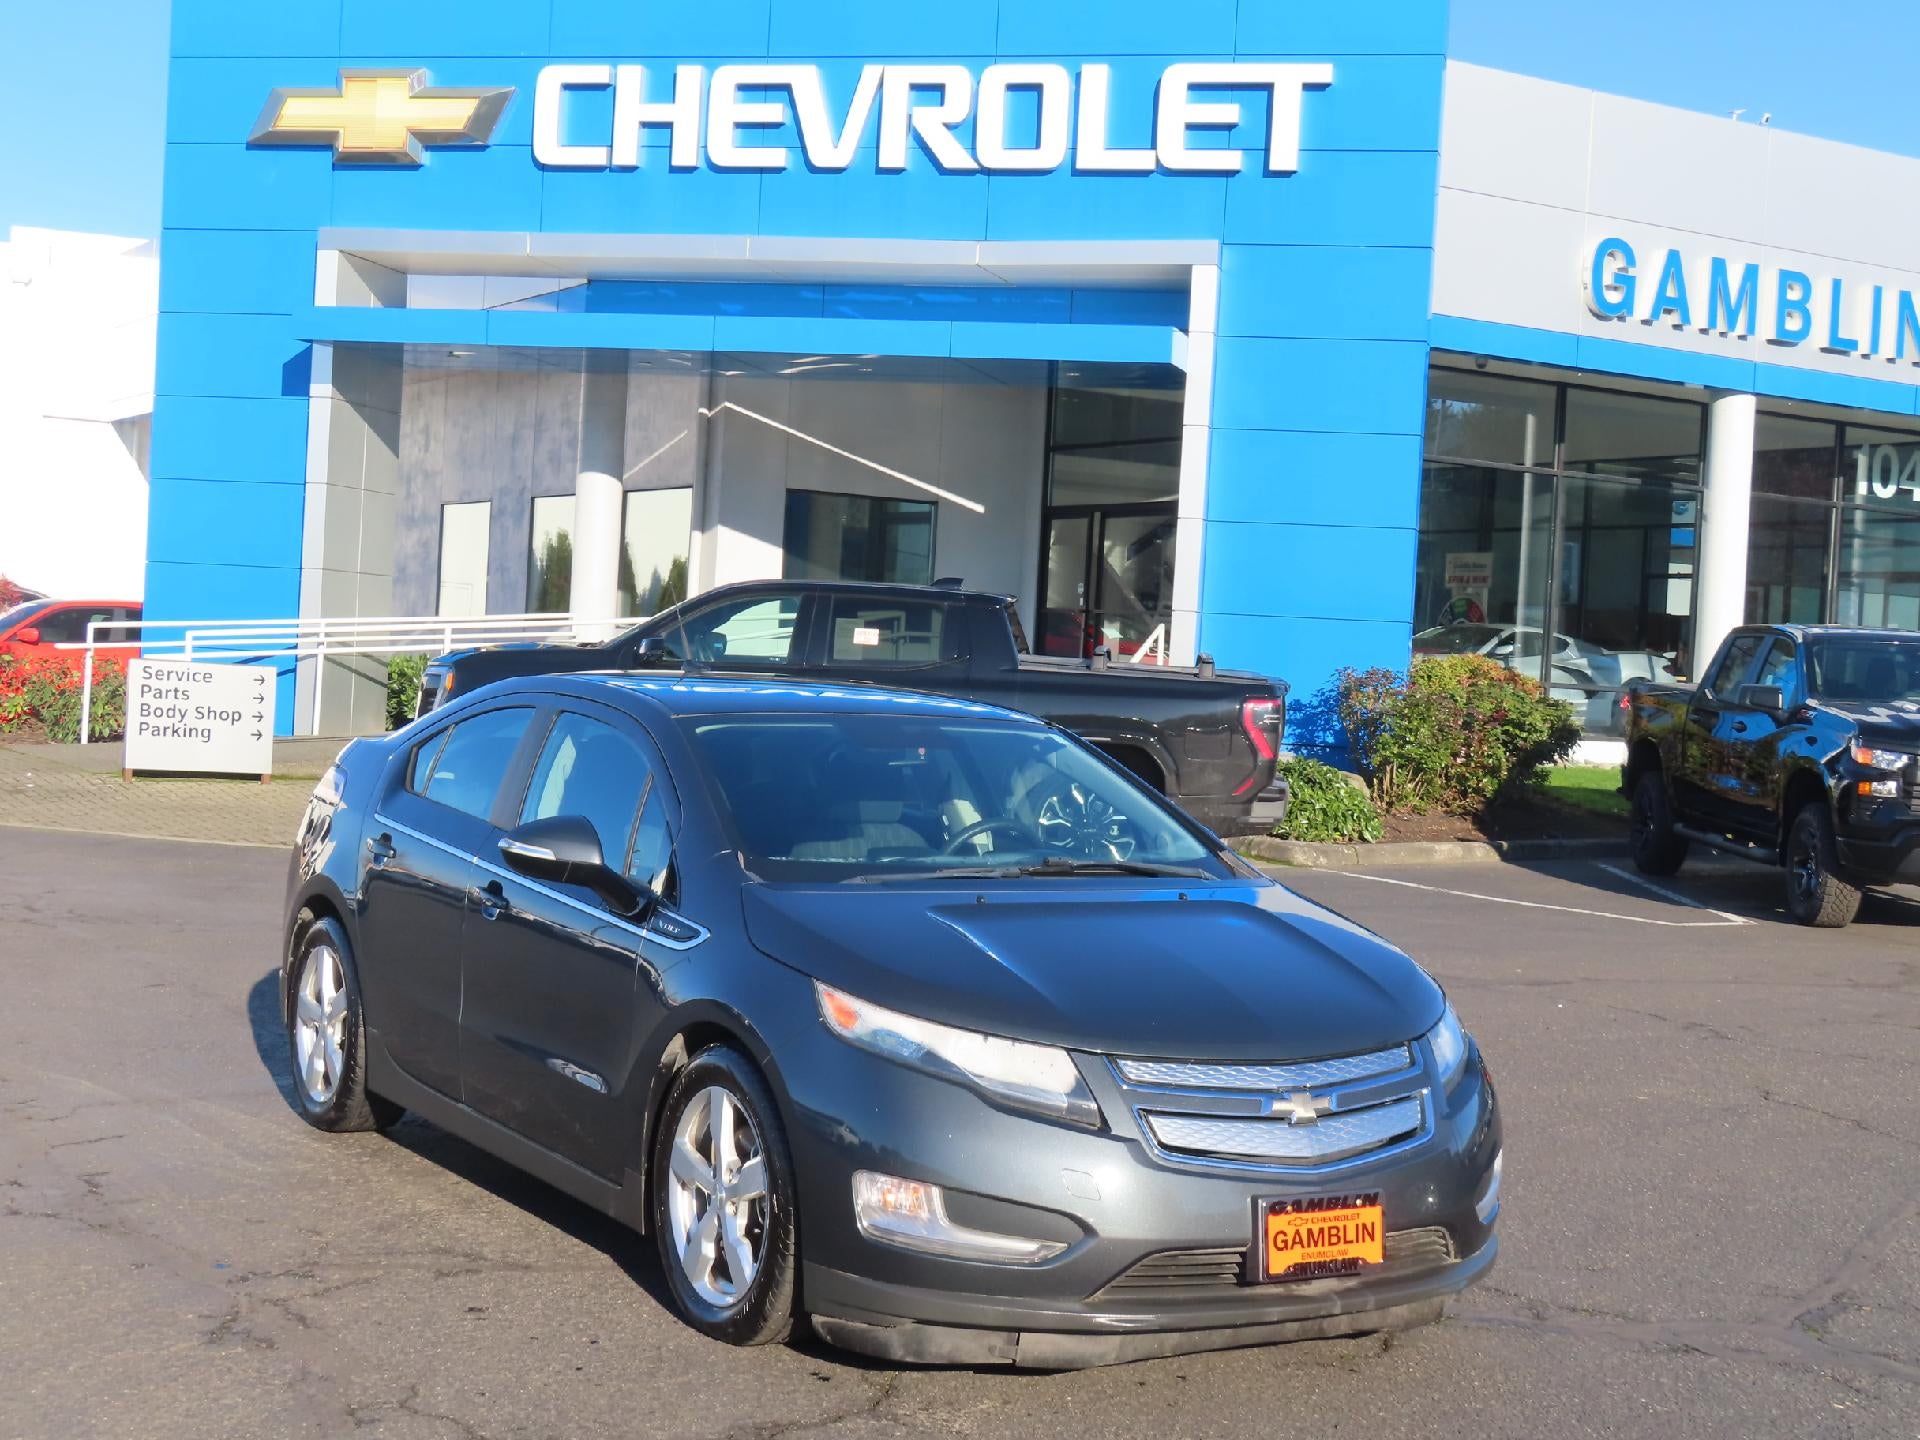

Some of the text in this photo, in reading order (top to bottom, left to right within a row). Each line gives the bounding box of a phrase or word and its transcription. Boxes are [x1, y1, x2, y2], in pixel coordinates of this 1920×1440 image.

[532, 64, 1334, 174] CHEVROLET
[1589, 236, 1920, 362] GAMBLIN
[142, 665, 213, 683] Service
[140, 684, 190, 701] Parts
[140, 702, 242, 726] Body Shop
[138, 721, 212, 743] Parking
[1269, 1191, 1380, 1216] GAMBLIN
[1311, 1212, 1360, 1225] CHEVROLET
[1272, 1221, 1375, 1252] GAMBLIN
[1301, 1248, 1349, 1261] ENUMCLAW
